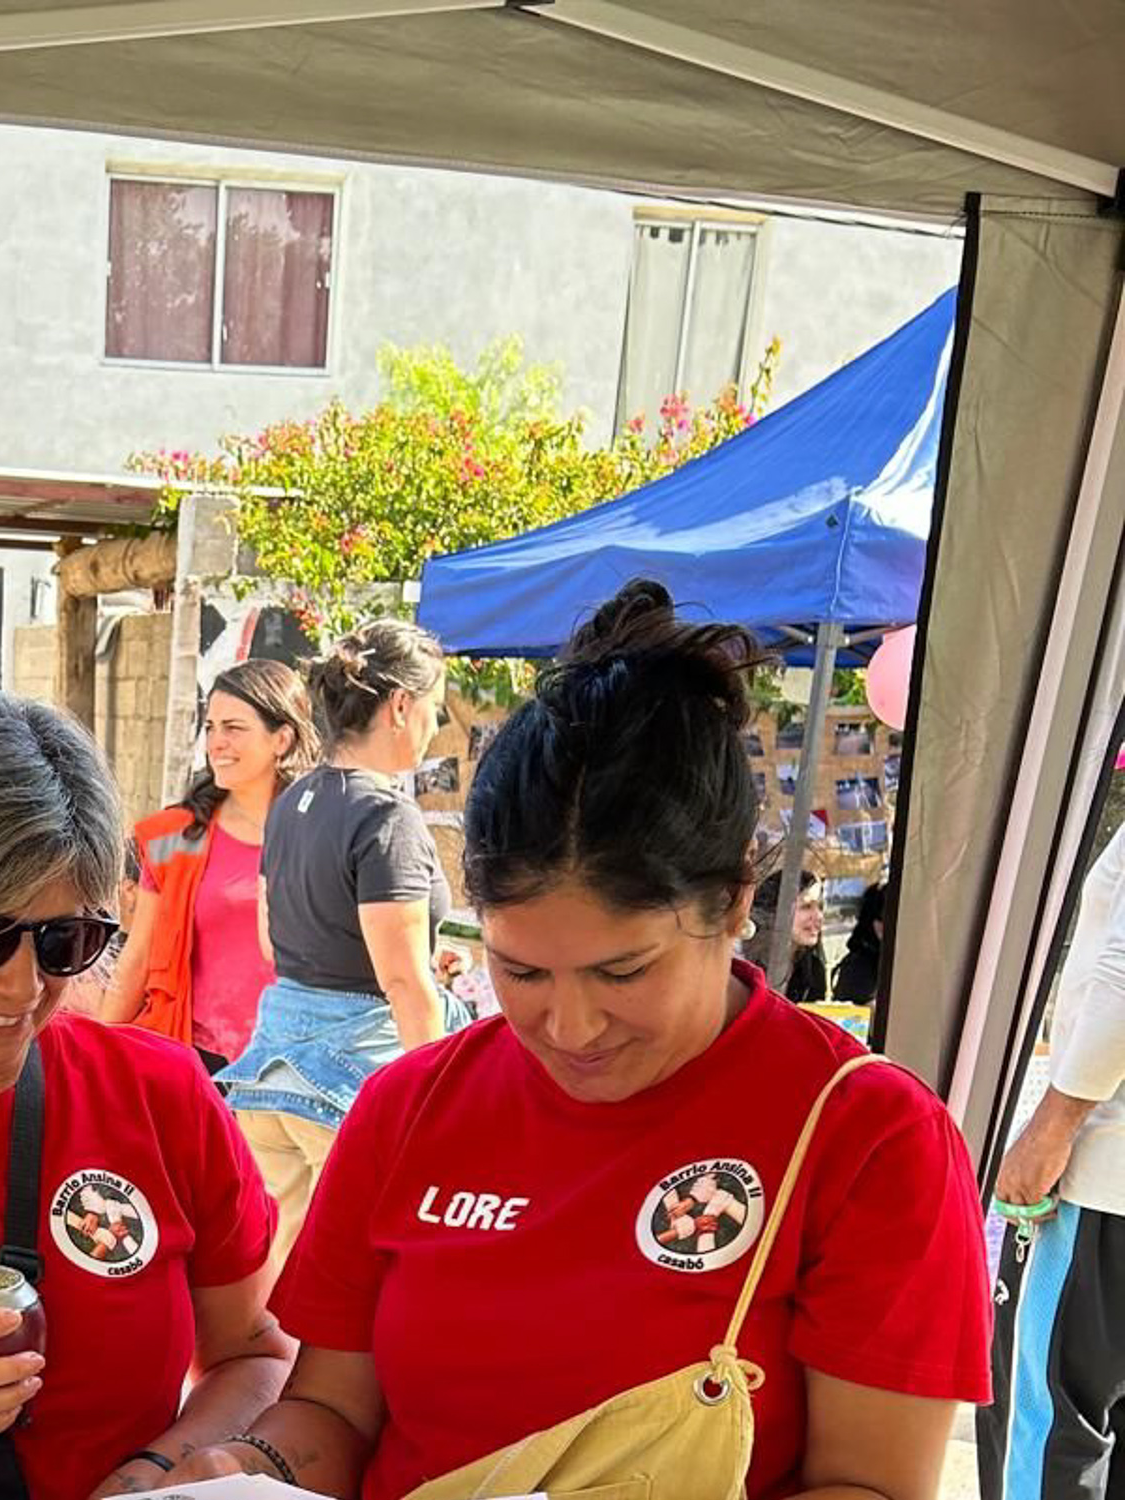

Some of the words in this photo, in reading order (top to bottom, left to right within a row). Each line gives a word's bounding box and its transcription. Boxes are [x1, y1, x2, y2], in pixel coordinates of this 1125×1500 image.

[52, 1178, 81, 1217] Barrio
[81, 1173, 123, 1190] Ansina
[659, 1164, 708, 1192] Barrio
[710, 1161, 756, 1187] Ansina
[417, 1185, 531, 1231] LORE
[657, 1253, 705, 1271] casabó
